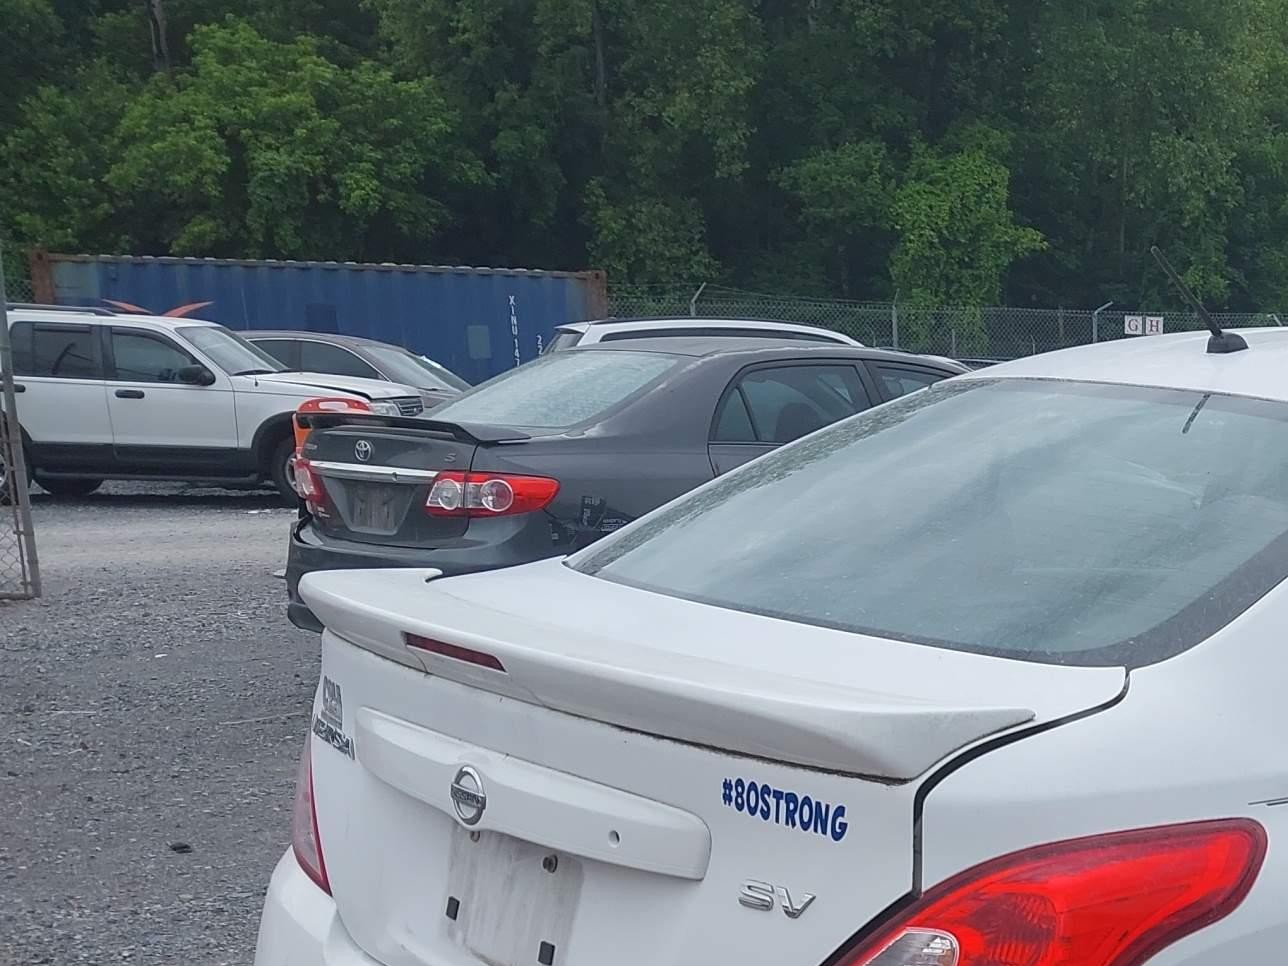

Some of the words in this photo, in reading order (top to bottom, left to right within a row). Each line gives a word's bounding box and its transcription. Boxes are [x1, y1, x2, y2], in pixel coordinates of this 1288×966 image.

[1128, 318, 1139, 332] G
[1149, 319, 1160, 333] H
[738, 879, 817, 919] SV
